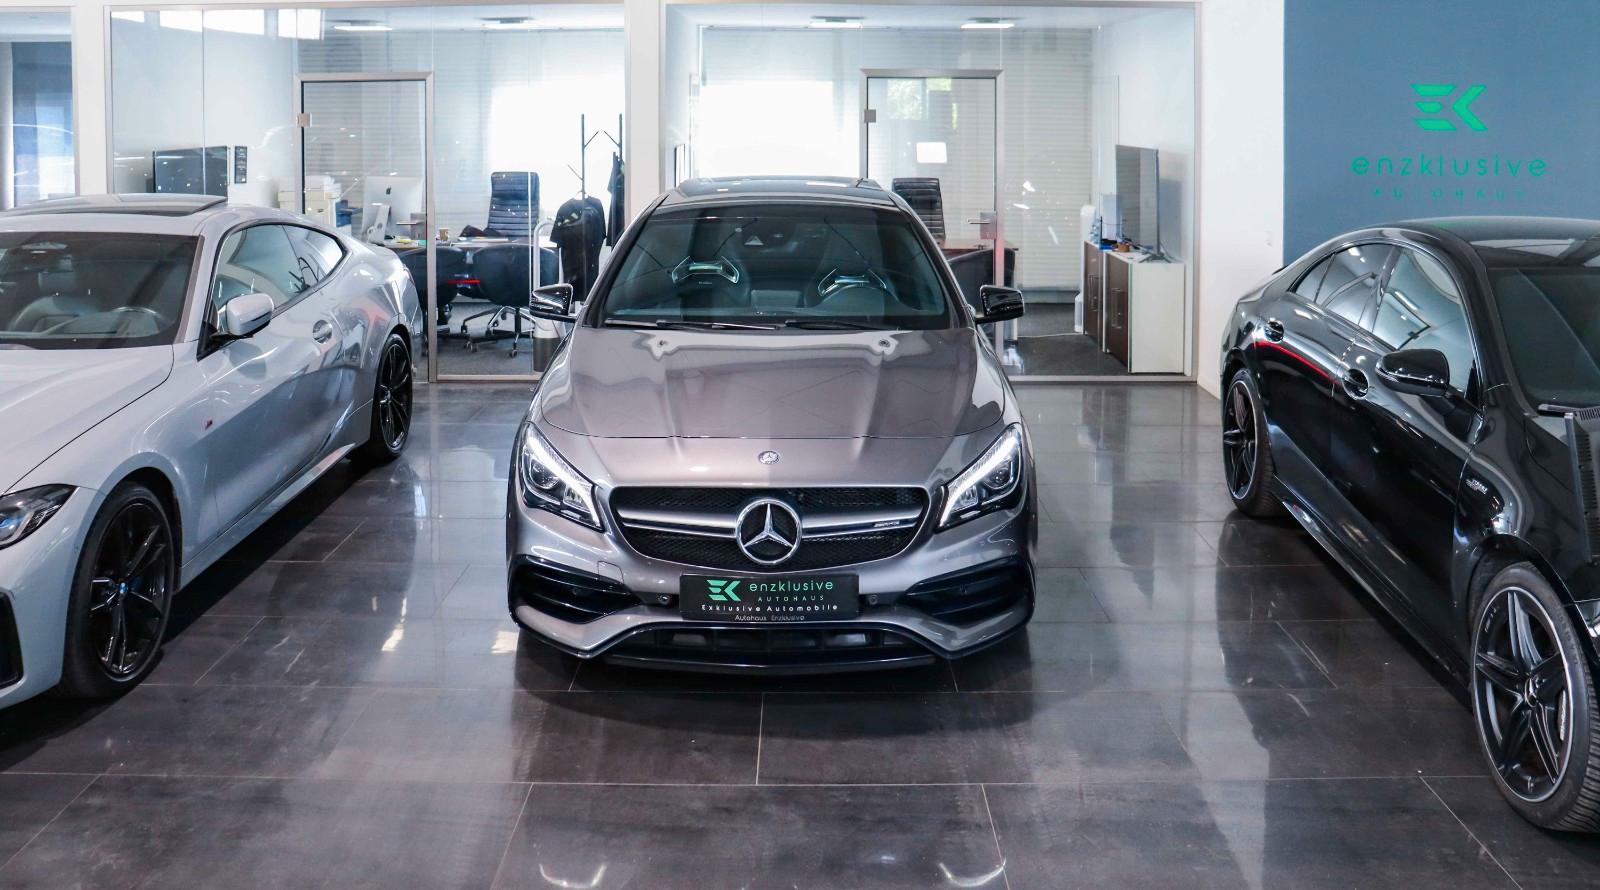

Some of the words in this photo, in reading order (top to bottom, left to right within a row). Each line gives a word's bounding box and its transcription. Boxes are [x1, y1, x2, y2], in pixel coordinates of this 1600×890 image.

[1351, 153, 1548, 177] enzklusive
[749, 580, 833, 592] enzklusive
[701, 604, 761, 612] Exklusive
[766, 604, 838, 612] Automobile
